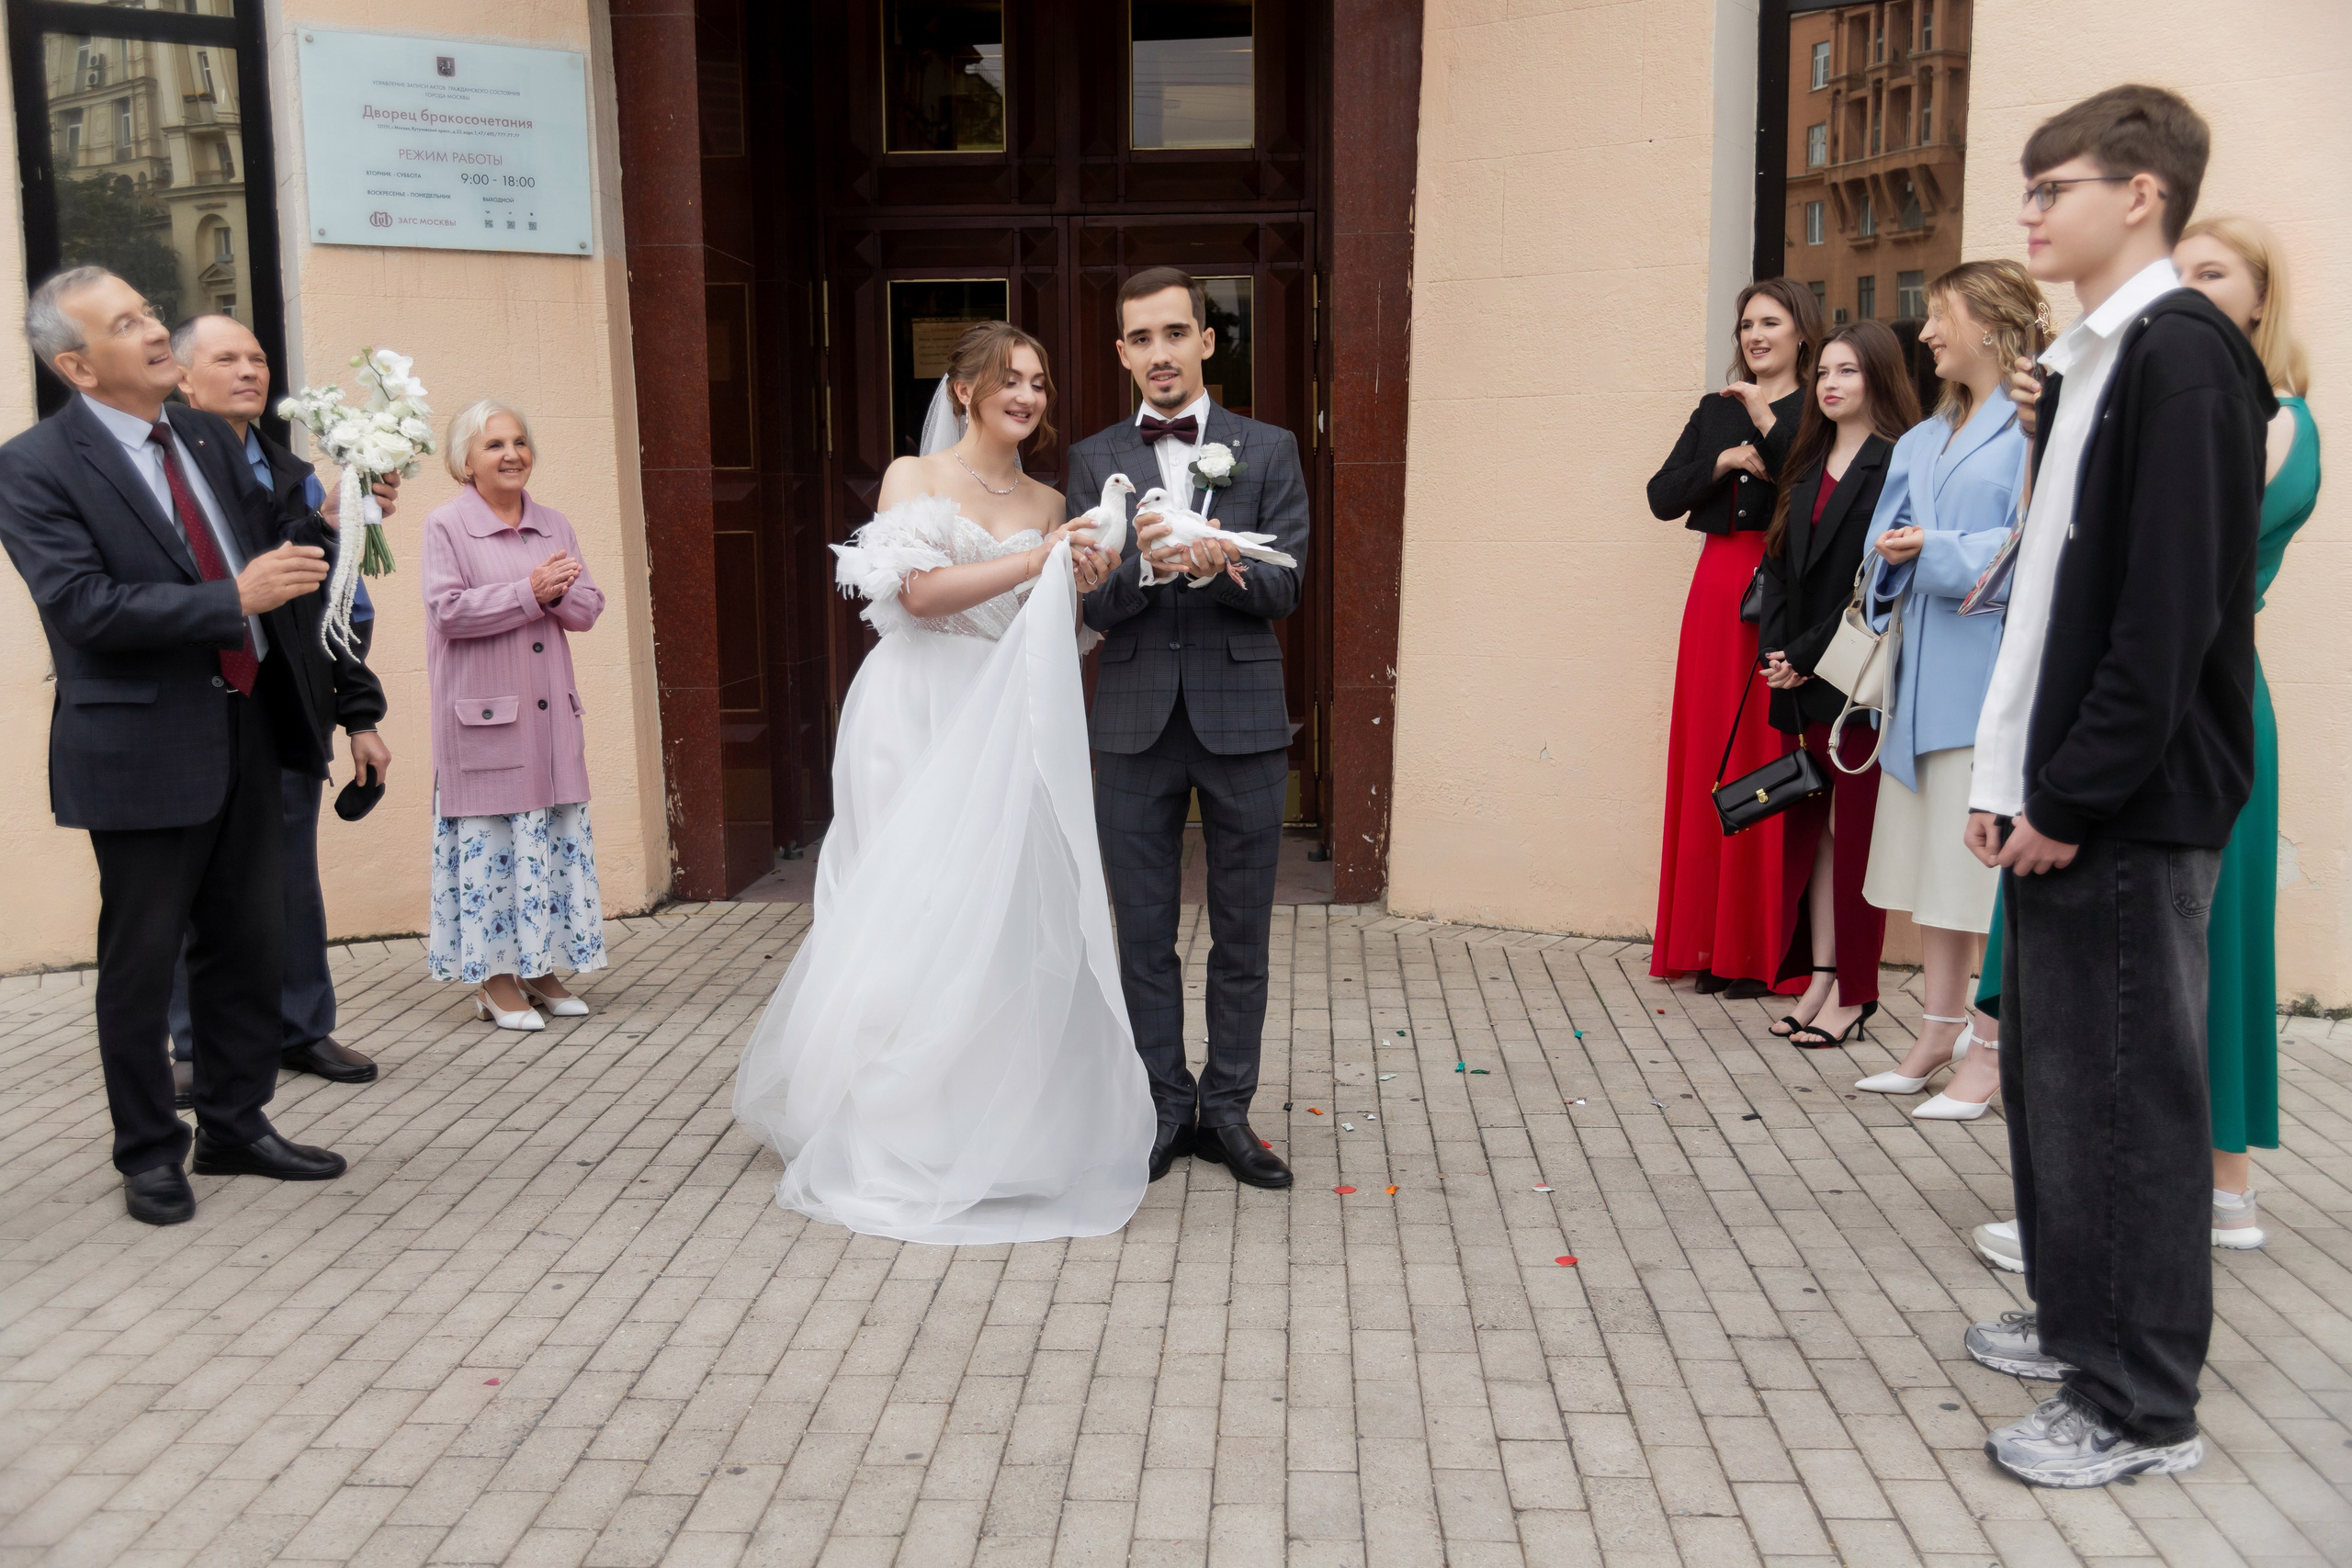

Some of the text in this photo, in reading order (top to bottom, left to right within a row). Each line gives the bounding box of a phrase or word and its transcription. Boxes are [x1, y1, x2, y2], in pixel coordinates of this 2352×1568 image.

[448, 86, 489, 95] ГРАЖДАНСКОГО
[362, 104, 533, 129] Дворец бракосочетания
[399, 148, 503, 165] РЕЖИМ РАБОТЫ
[460, 173, 490, 186] 9:00
[503, 175, 536, 188] 18:00
